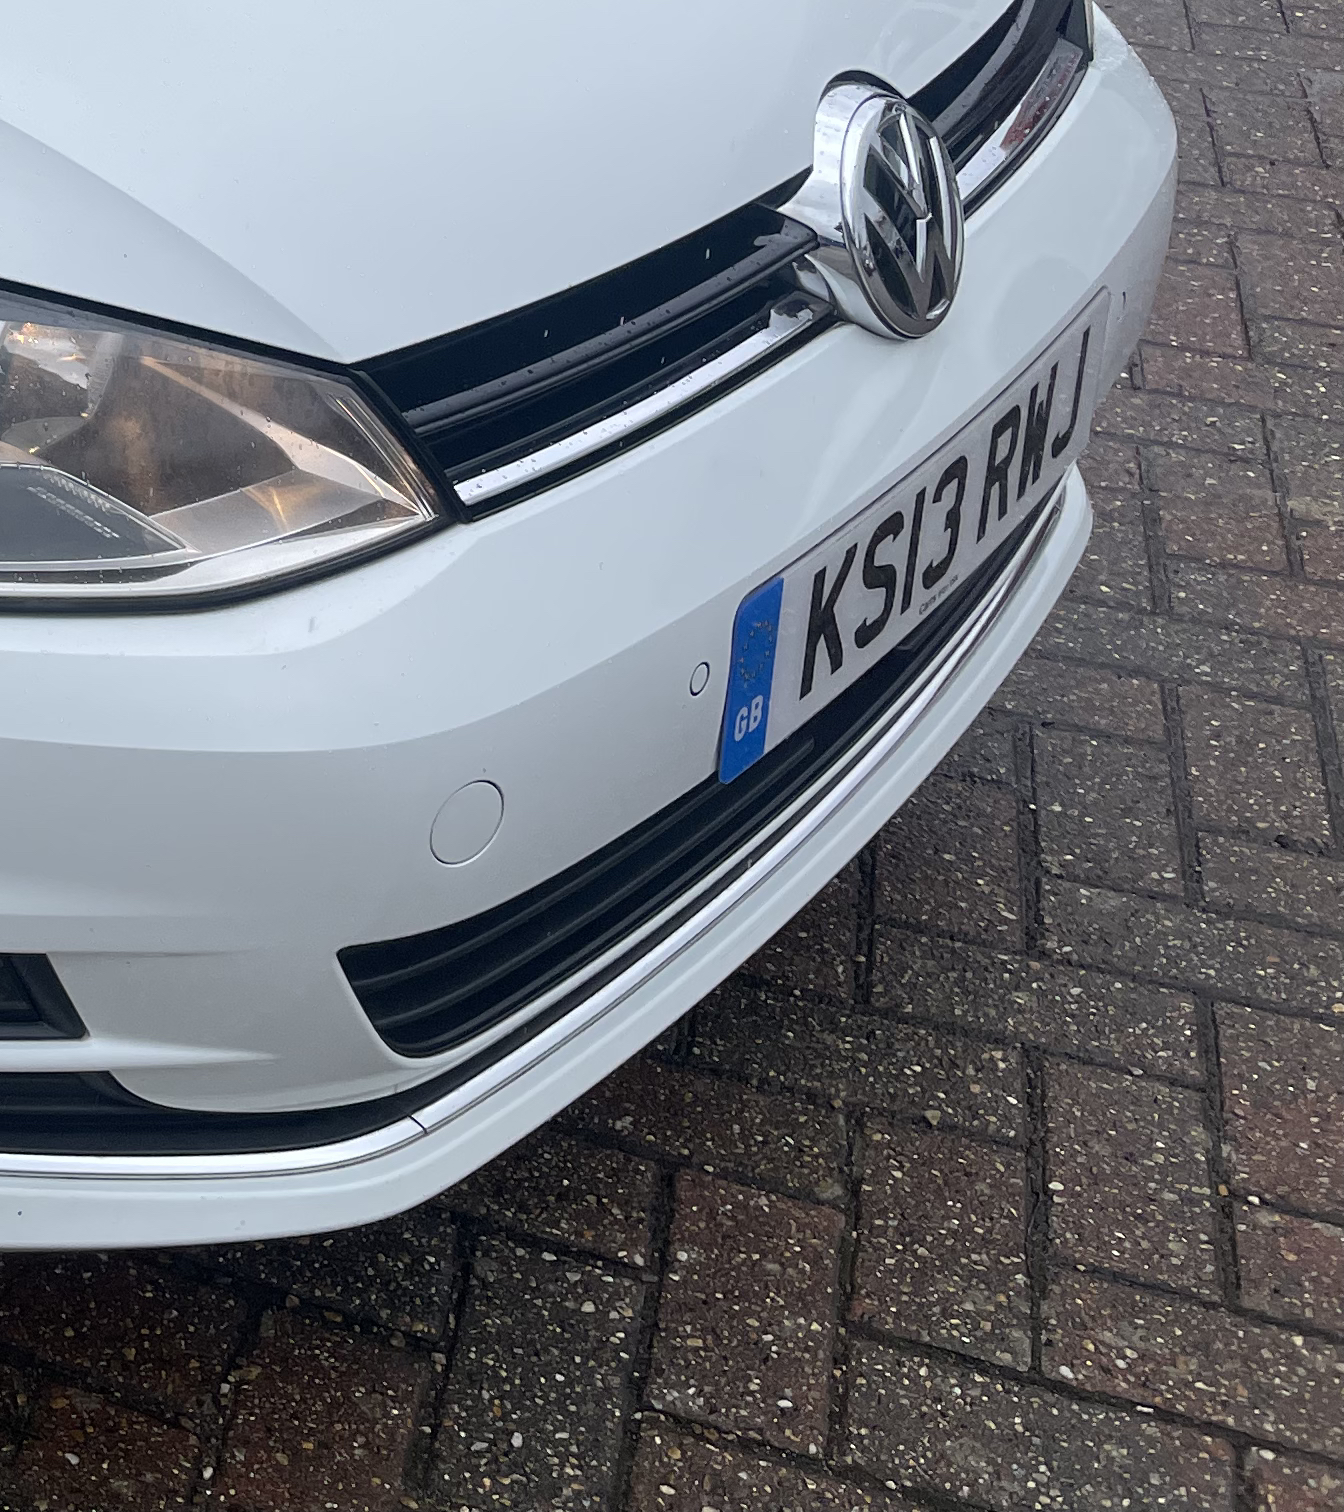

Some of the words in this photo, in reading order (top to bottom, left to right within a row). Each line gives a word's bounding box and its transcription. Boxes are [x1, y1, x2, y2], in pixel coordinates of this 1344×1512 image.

[798, 454, 970, 702] KS13
[976, 324, 1091, 545] RWJ
[734, 694, 764, 742] GB
